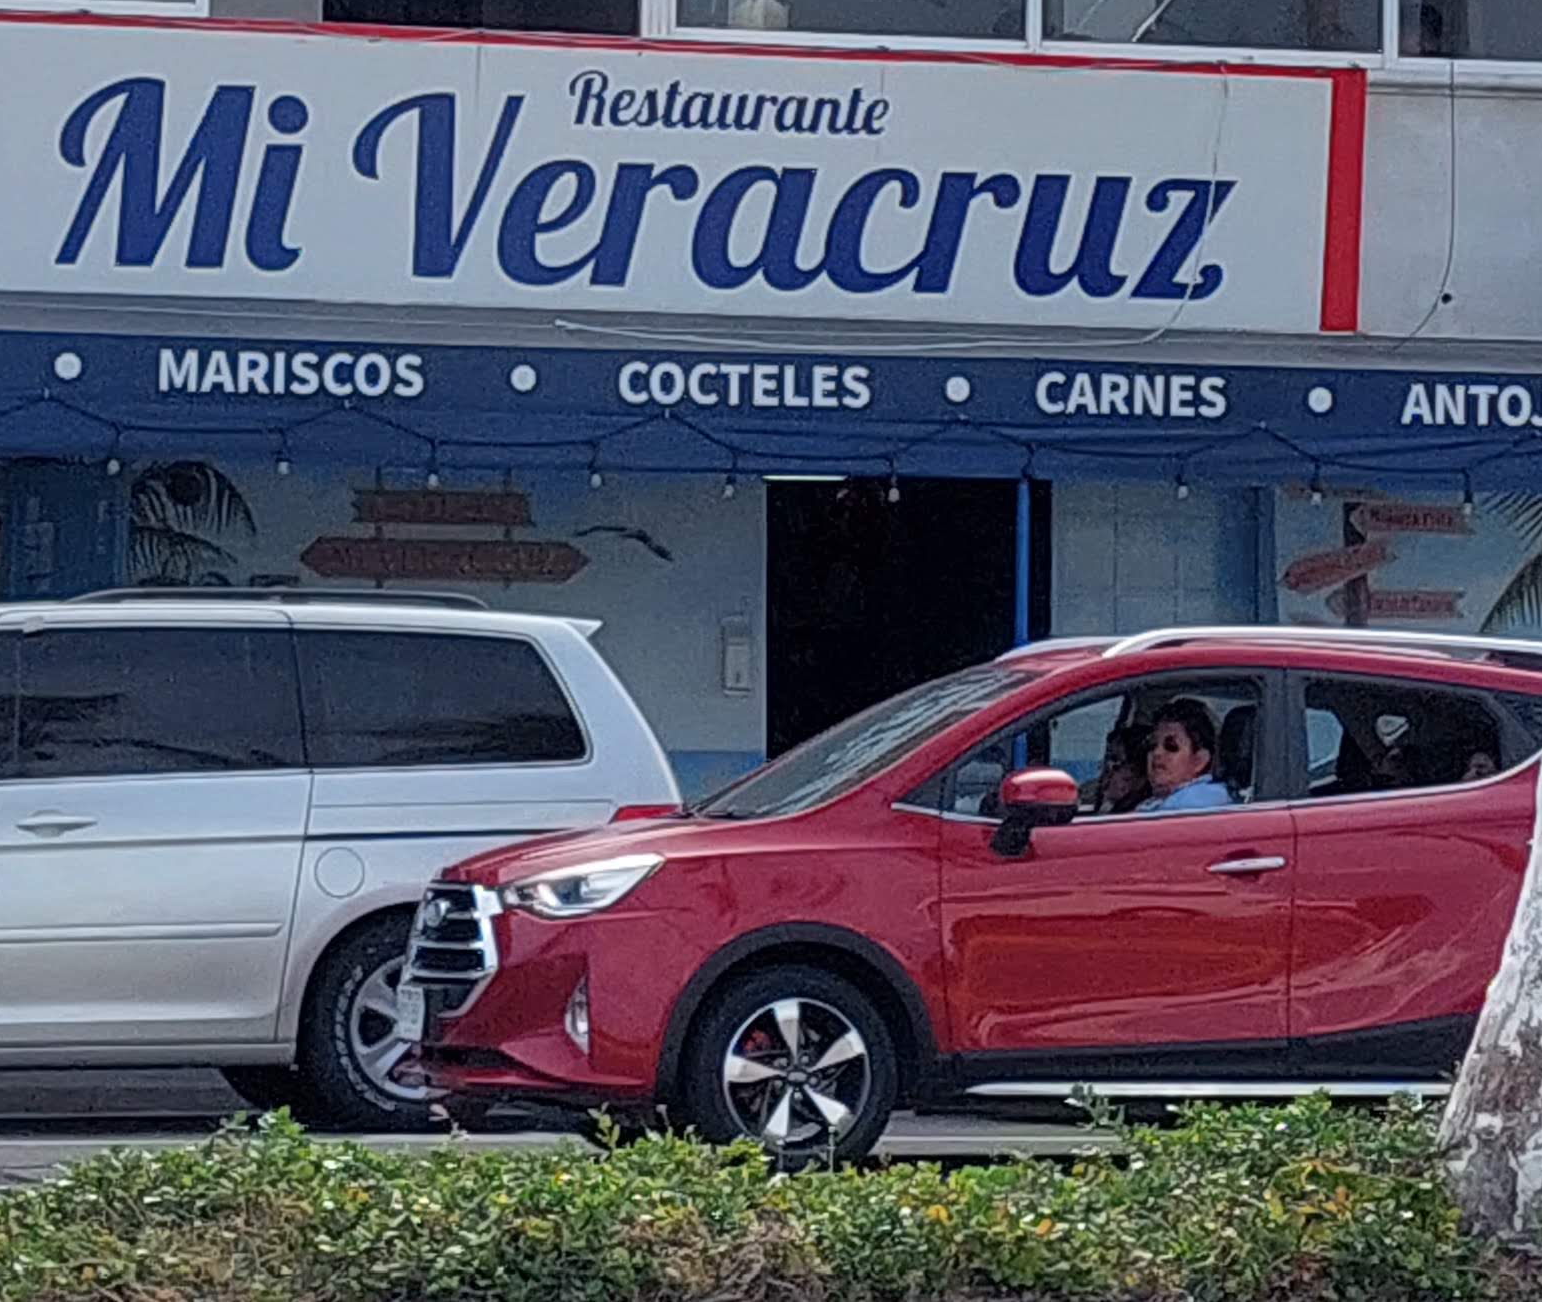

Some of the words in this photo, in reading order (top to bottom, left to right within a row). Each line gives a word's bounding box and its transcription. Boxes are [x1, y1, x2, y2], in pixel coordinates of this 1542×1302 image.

[568, 70, 890, 135] Restaurante
[54, 76, 310, 273] Mi
[352, 93, 1237, 301] Veracruz
[159, 348, 425, 398] MARISCOS
[618, 361, 871, 409] COCTELES
[1035, 371, 1227, 418] CARNES
